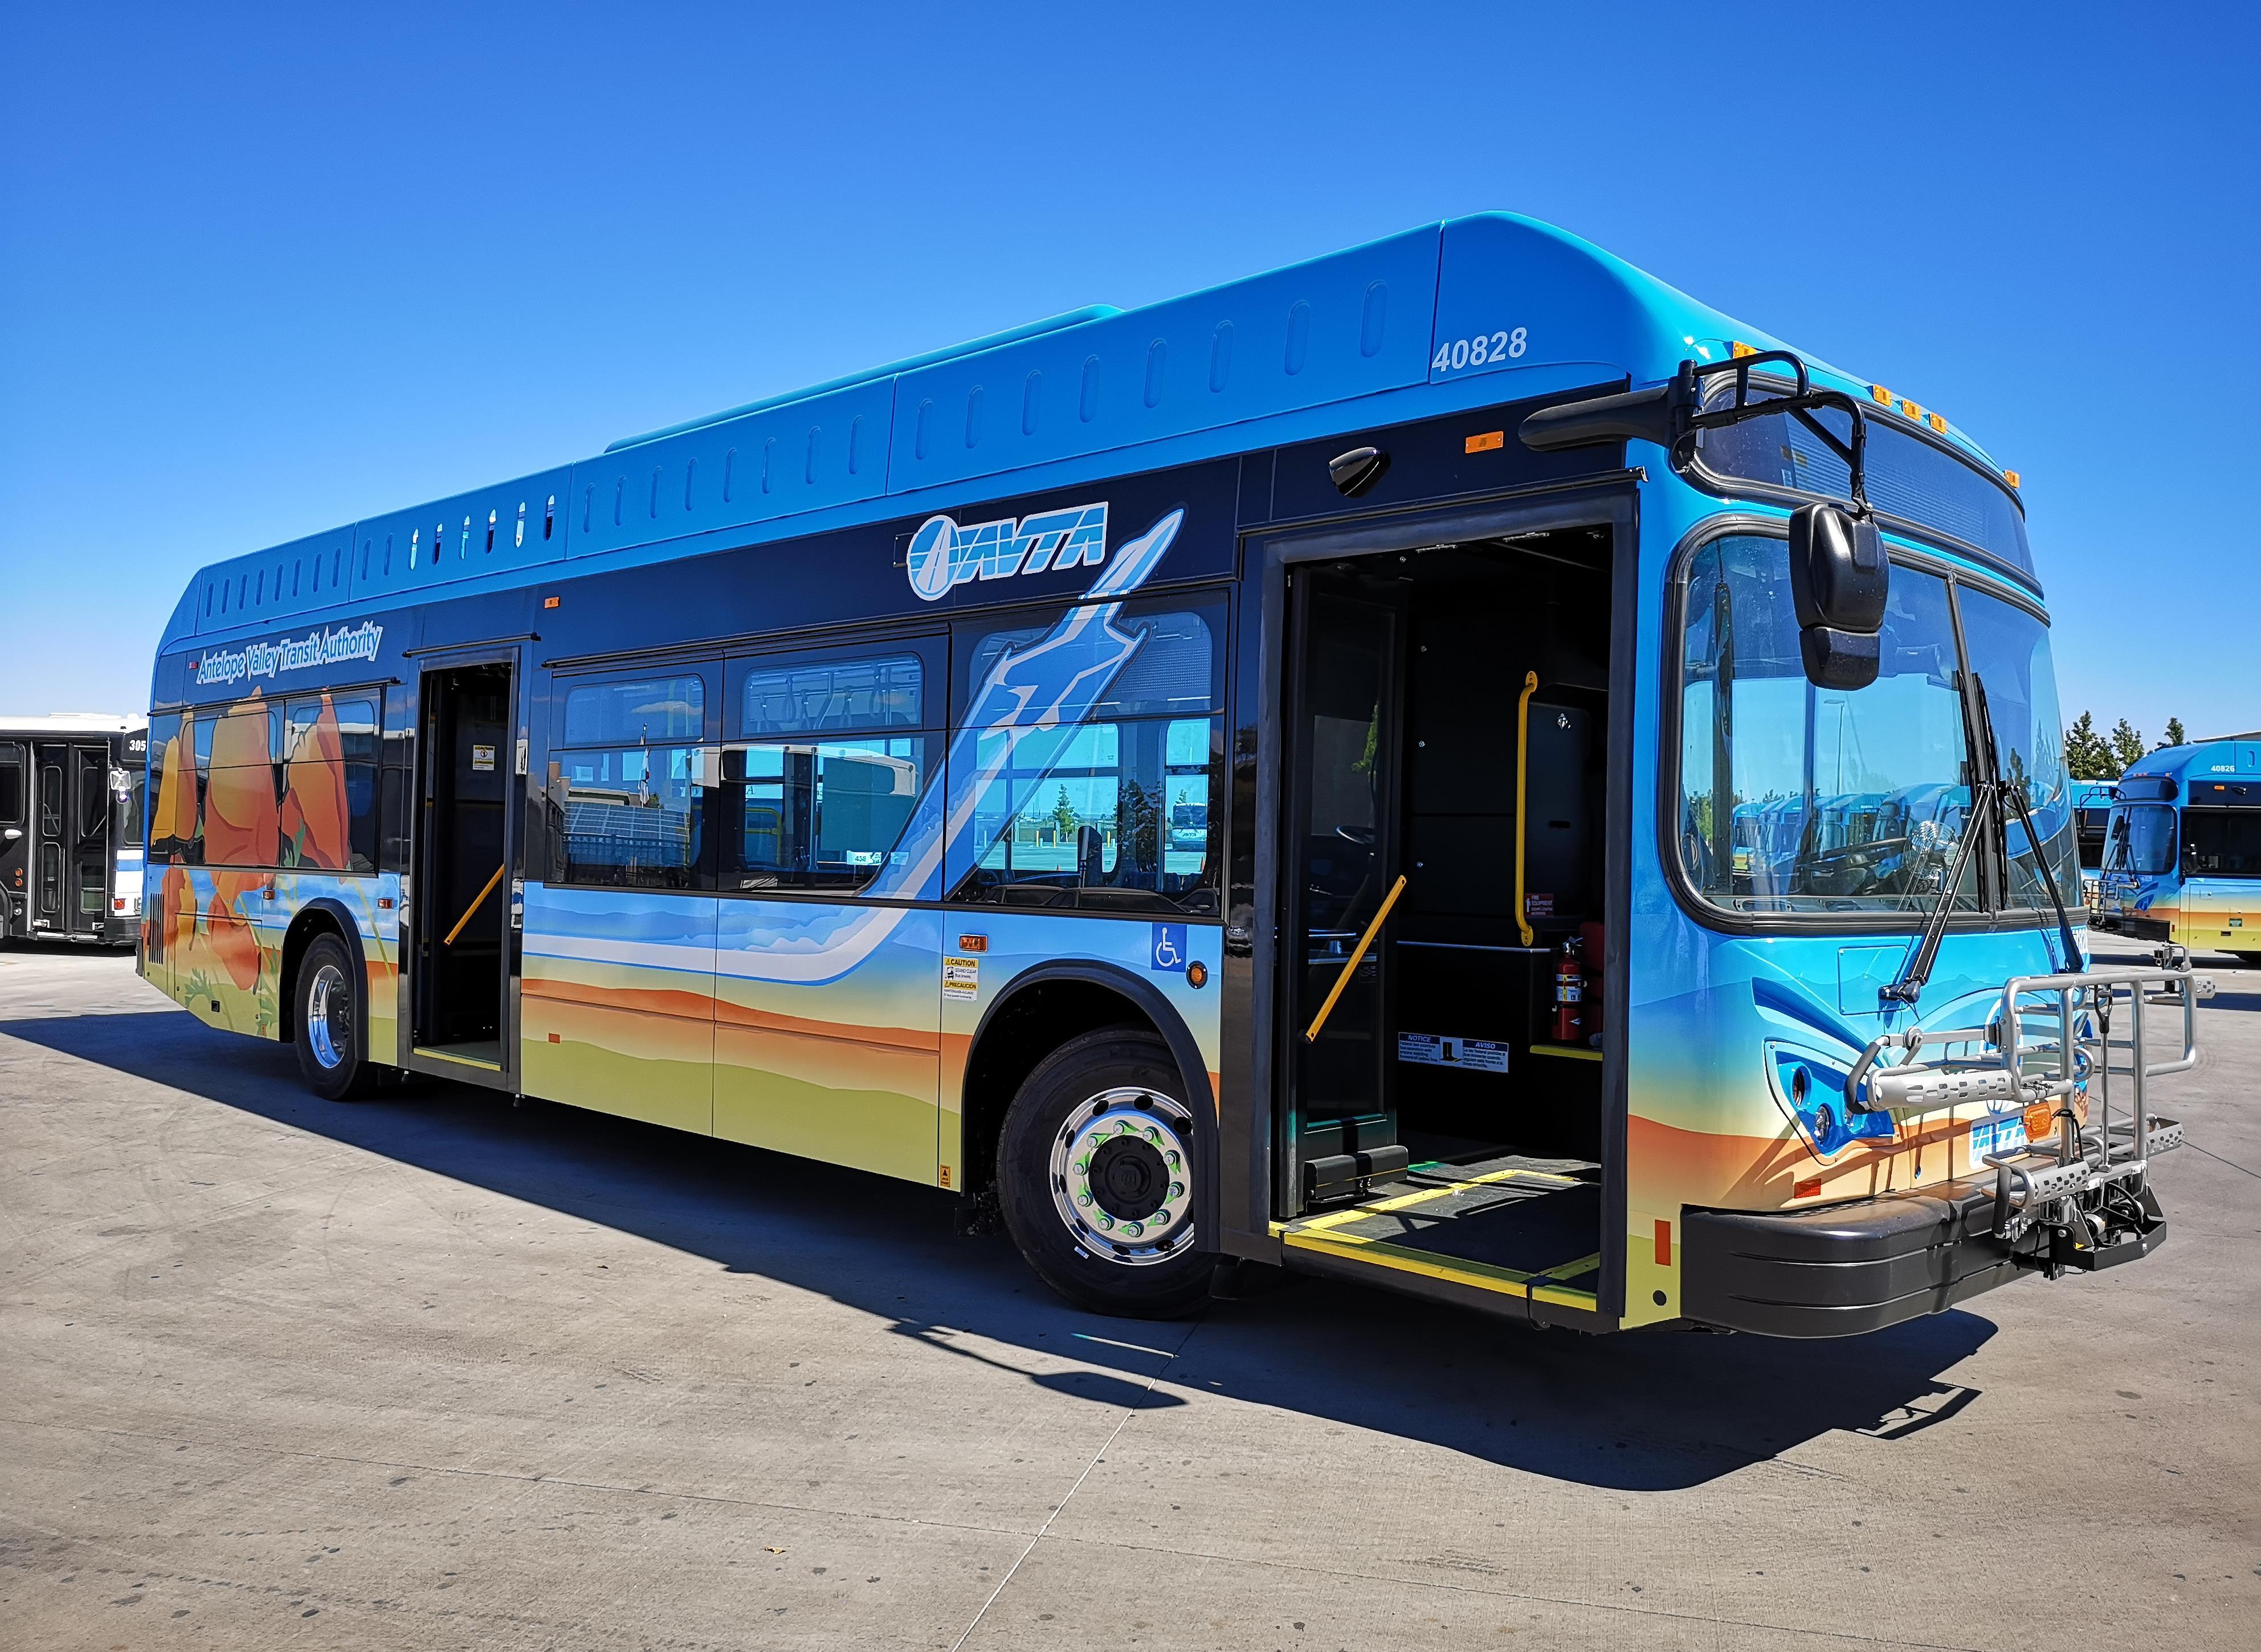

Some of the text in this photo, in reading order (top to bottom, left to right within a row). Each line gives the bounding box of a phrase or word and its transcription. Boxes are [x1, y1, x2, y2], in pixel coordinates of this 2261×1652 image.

[1431, 327, 1527, 372] 40828
[954, 501, 1108, 584] AVTA
[196, 620, 383, 684] Antelope Valley Transit Authority
[129, 739, 146, 751] 305
